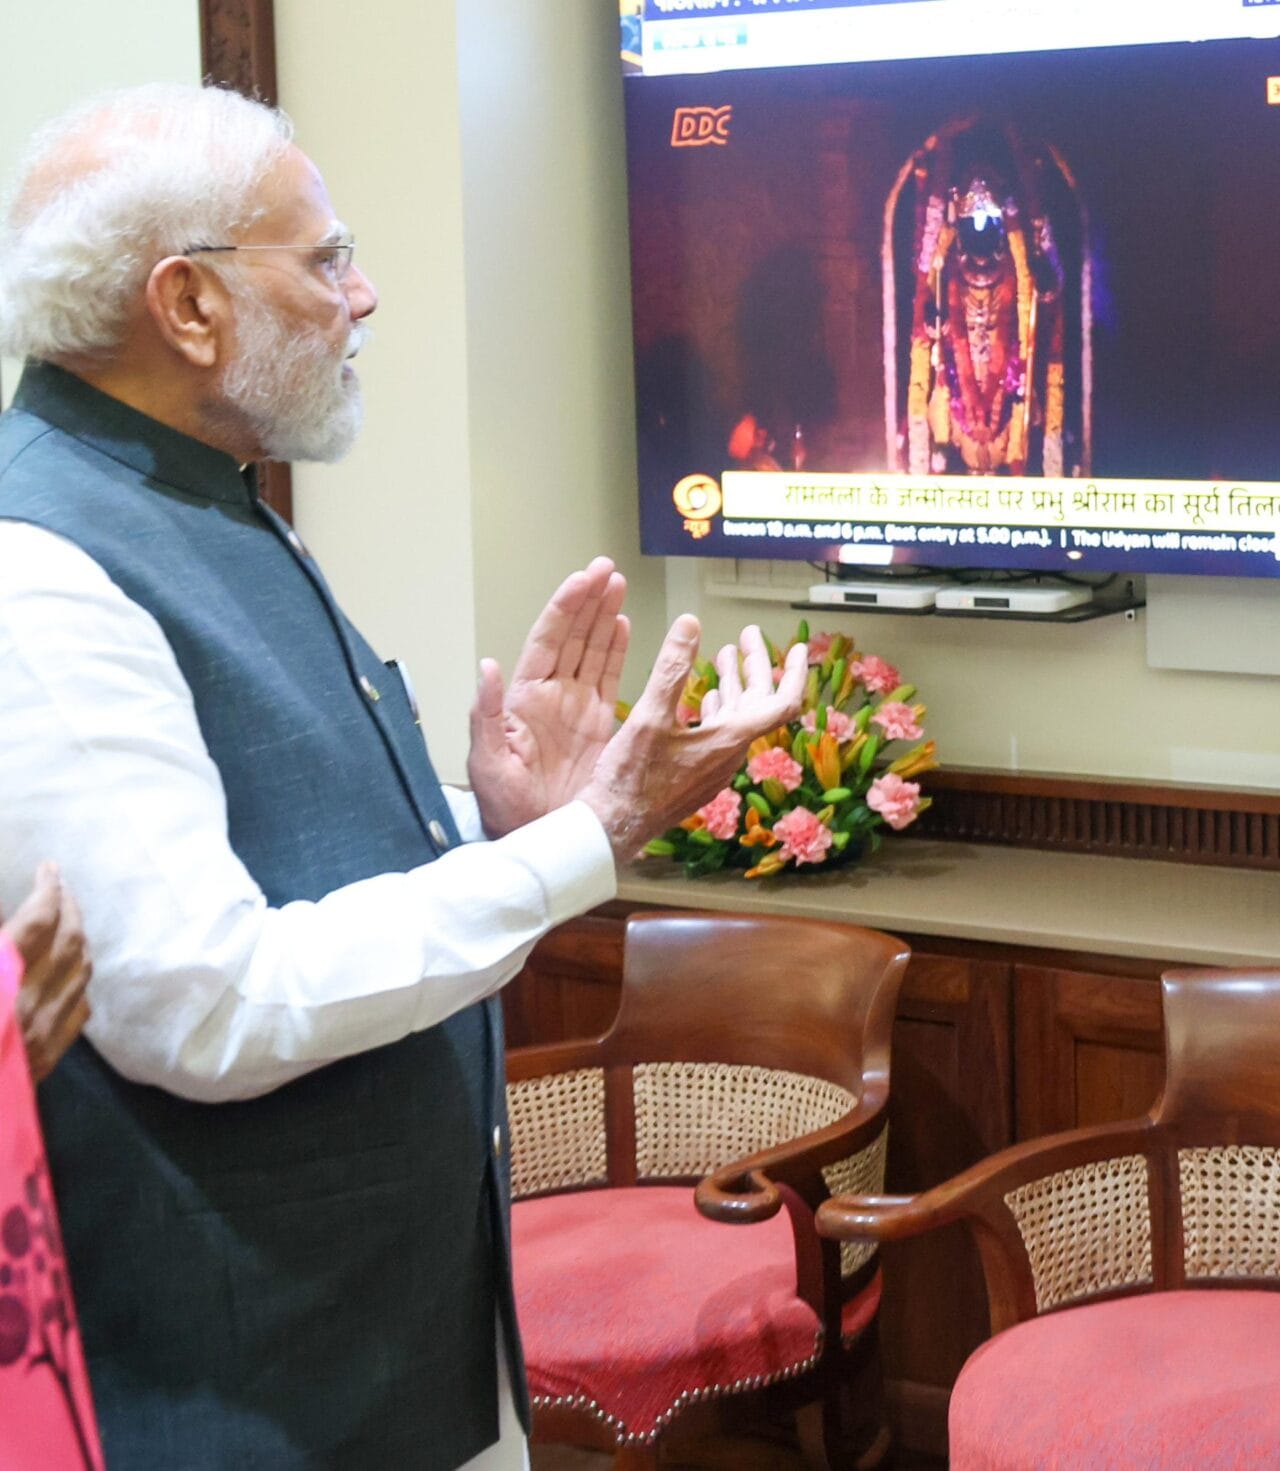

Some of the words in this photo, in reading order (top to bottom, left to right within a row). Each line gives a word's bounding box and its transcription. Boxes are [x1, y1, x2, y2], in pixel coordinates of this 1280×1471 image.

[785, 485, 862, 504] रामलला
[868, 484, 889, 508] के
[898, 485, 990, 510] जन्मोत्सव
[998, 489, 1024, 509] पर
[1032, 490, 1065, 521] प्रभु
[1071, 484, 1137, 512] श्रीराम
[1145, 493, 1175, 514] का
[1184, 487, 1221, 524] सूर्य
[784, 524, 813, 538] a.m.
[814, 522, 841, 539] and
[854, 526, 884, 542] p.m.
[918, 527, 958, 546] entry
[959, 528, 976, 544] at
[1072, 530, 1100, 546] The
[1103, 531, 1150, 551] Udyan
[1152, 533, 1180, 549] will
[1182, 534, 1237, 551] remain
